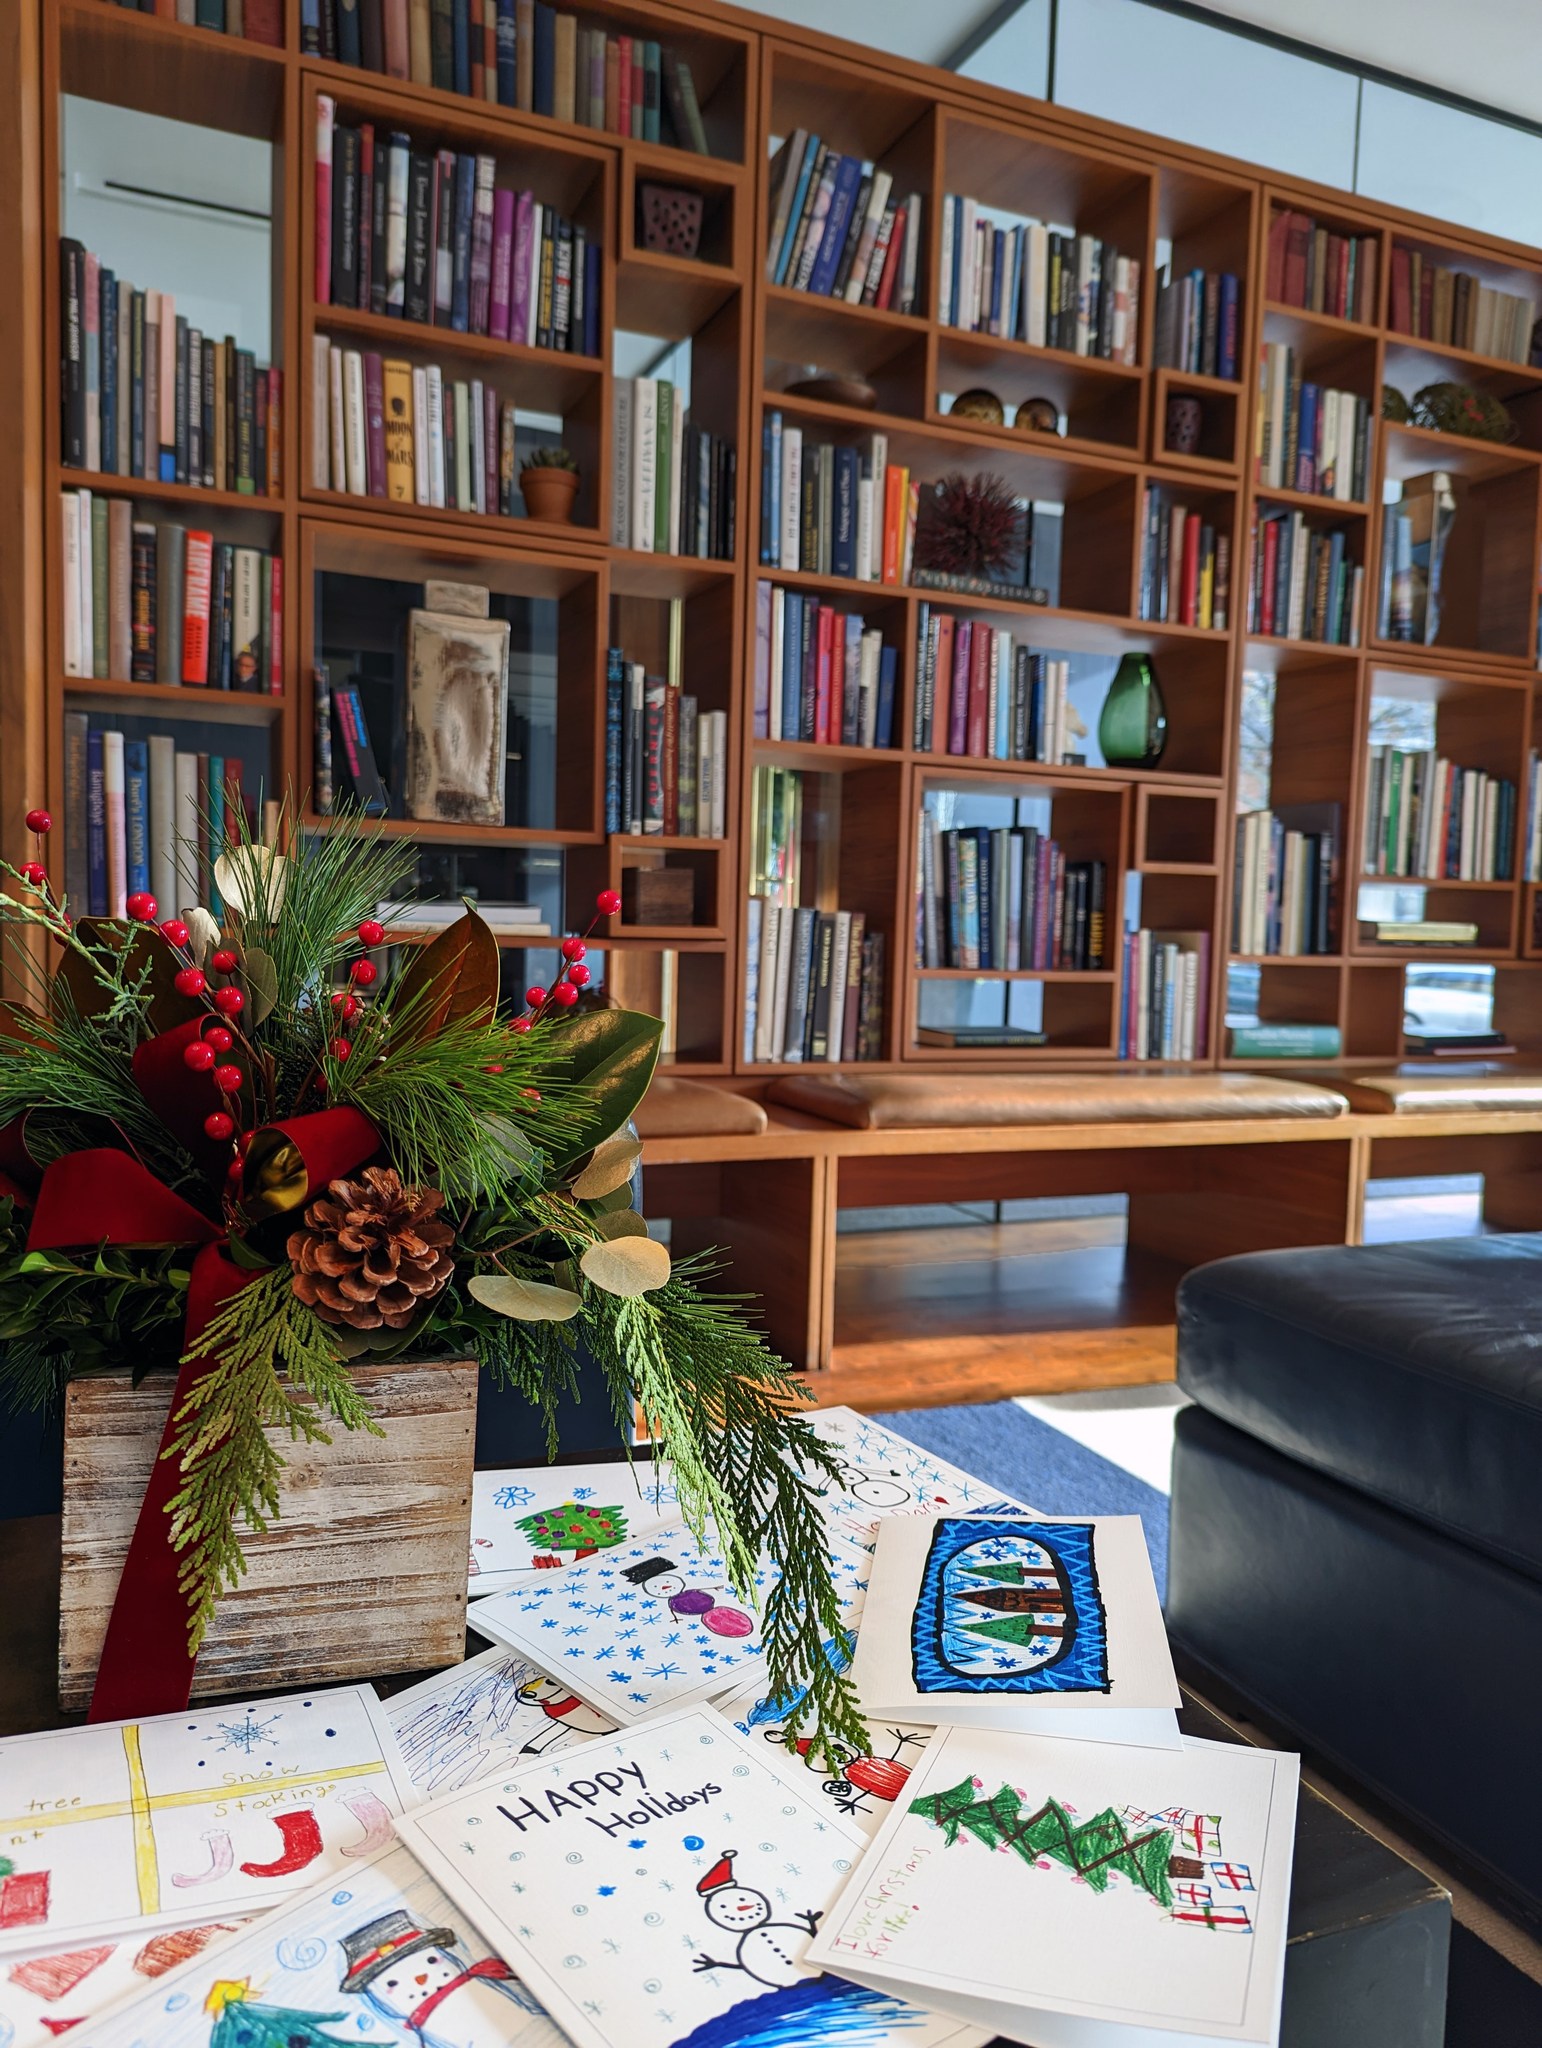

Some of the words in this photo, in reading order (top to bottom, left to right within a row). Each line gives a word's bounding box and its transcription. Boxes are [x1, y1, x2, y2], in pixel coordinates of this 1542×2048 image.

[556, 241, 573, 279] BACK
[554, 286, 570, 332] FIRING
[187, 540, 209, 620] AIRFRAME
[131, 816, 145, 866] LONDON
[766, 907, 777, 956] MUNCH
[852, 920, 863, 939] The
[851, 939, 862, 957] Art
[848, 957, 860, 987] World
[26, 1796, 82, 1812] tree
[585, 1782, 722, 1838] Holidays
[843, 1911, 877, 1940] love
[835, 1937, 858, 1950] I
